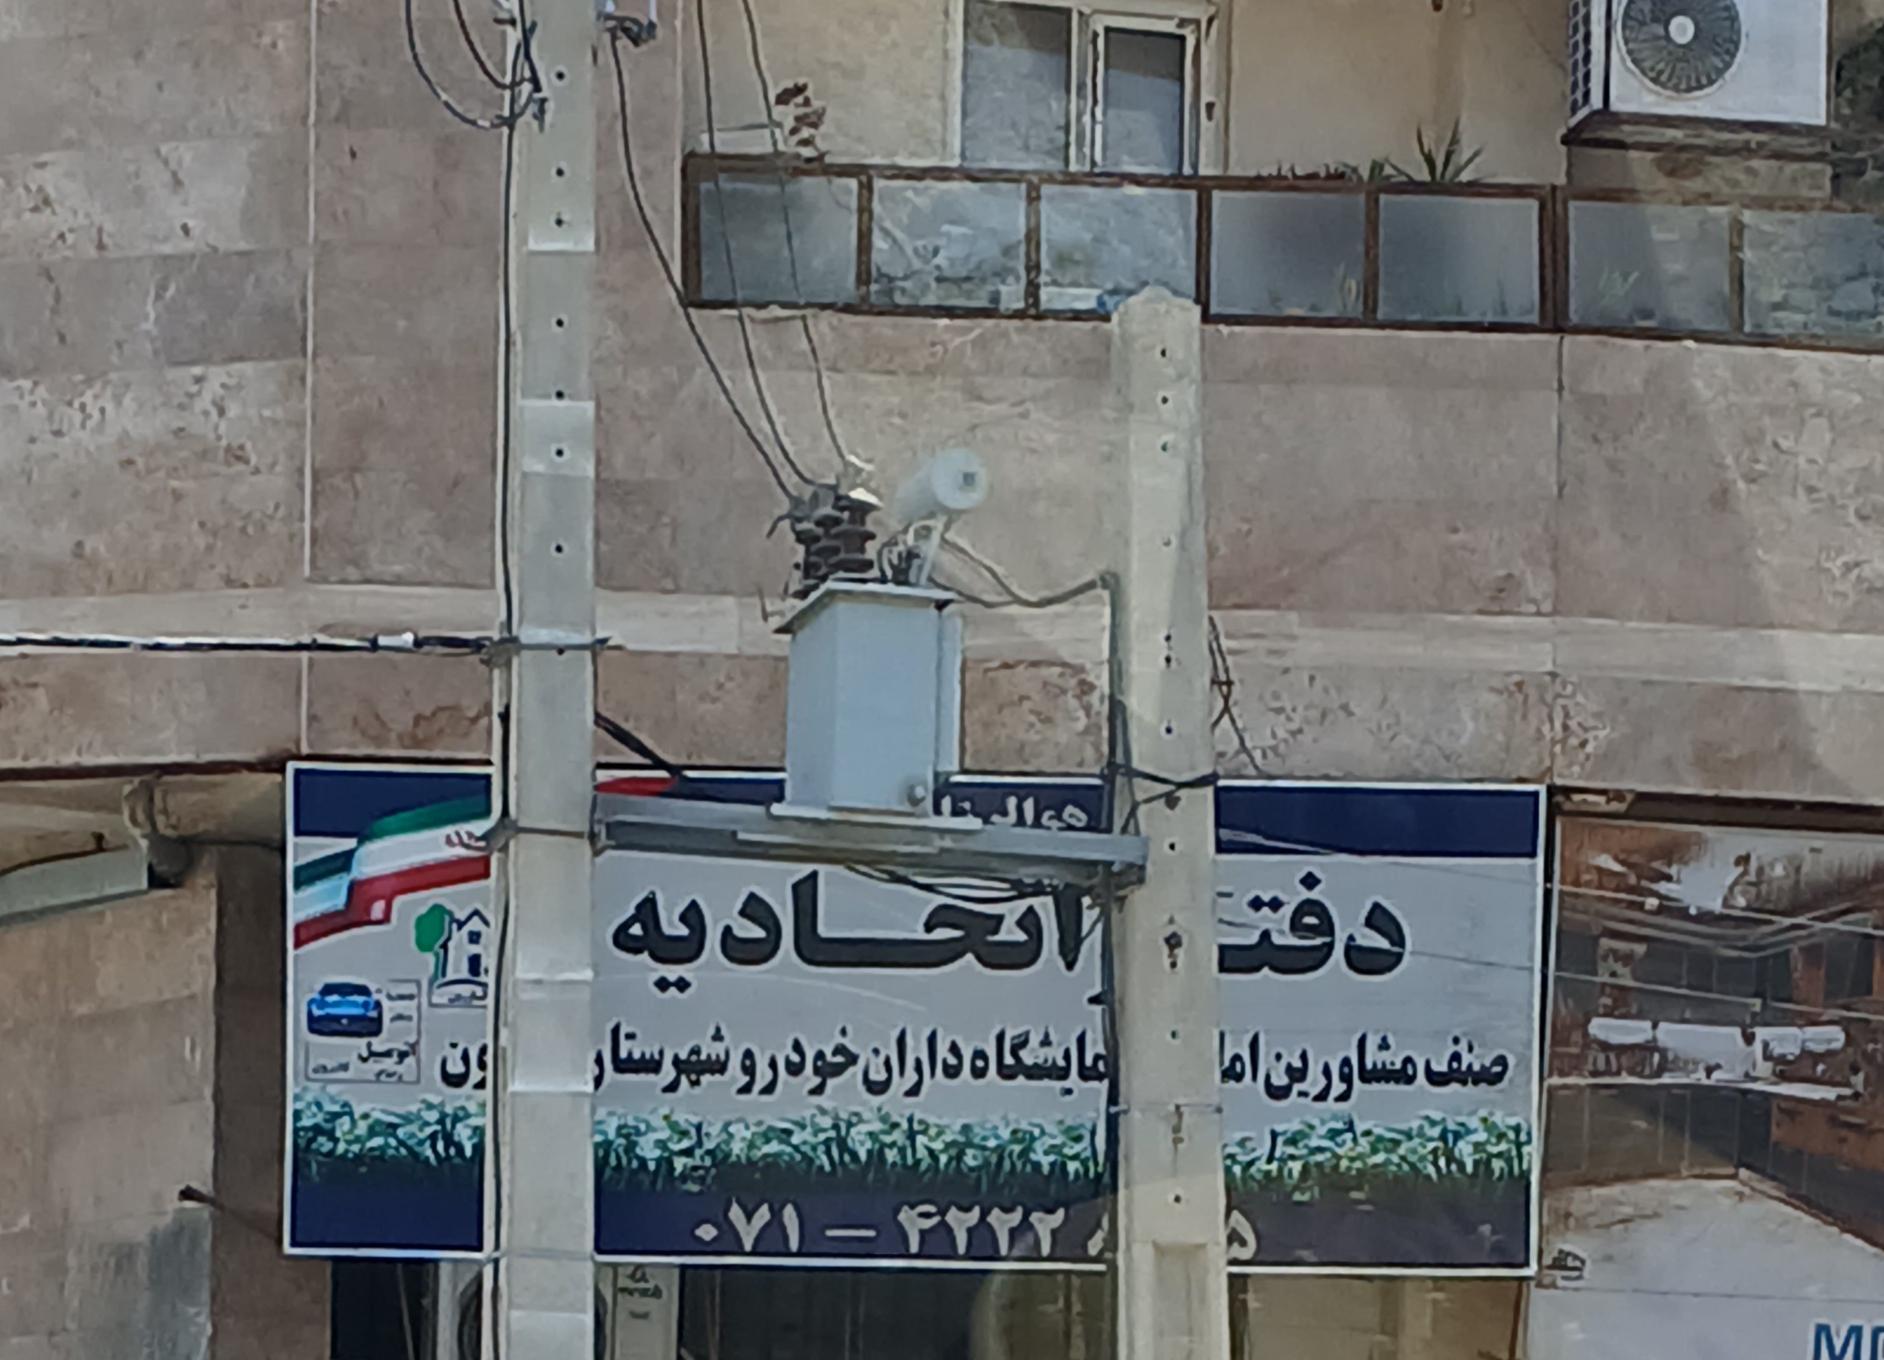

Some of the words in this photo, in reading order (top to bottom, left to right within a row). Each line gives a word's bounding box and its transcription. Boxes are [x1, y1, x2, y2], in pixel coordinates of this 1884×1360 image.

[861, 1026, 965, 1097] داران
[970, 1026, 1108, 1097] مایشگاه
[1264, 1031, 1418, 1102] مشاورین
[1424, 1035, 1510, 1087] صنف
